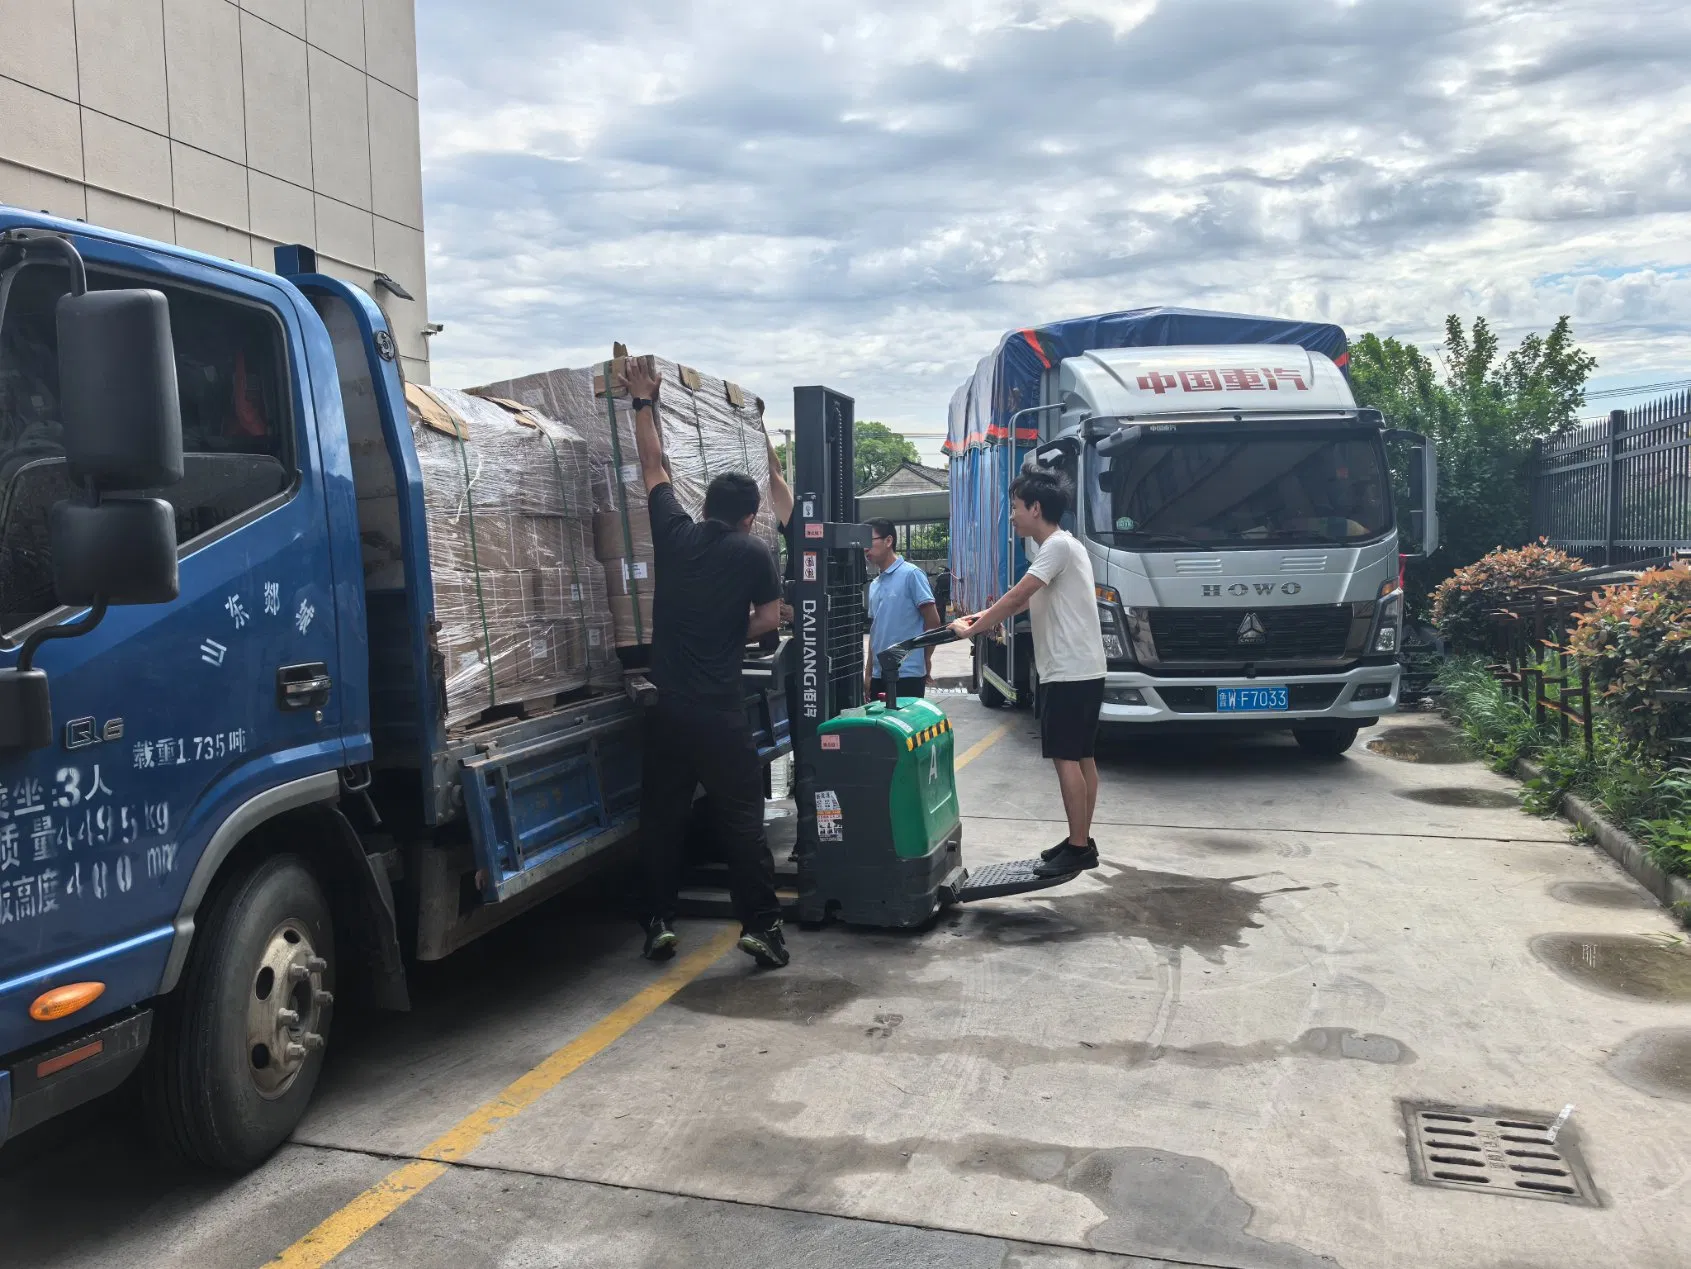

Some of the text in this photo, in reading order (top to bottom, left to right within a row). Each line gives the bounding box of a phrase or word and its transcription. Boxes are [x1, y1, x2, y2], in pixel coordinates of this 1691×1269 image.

[1136, 368, 1309, 394] 中国重汽
[1201, 582, 1302, 596] HOWO
